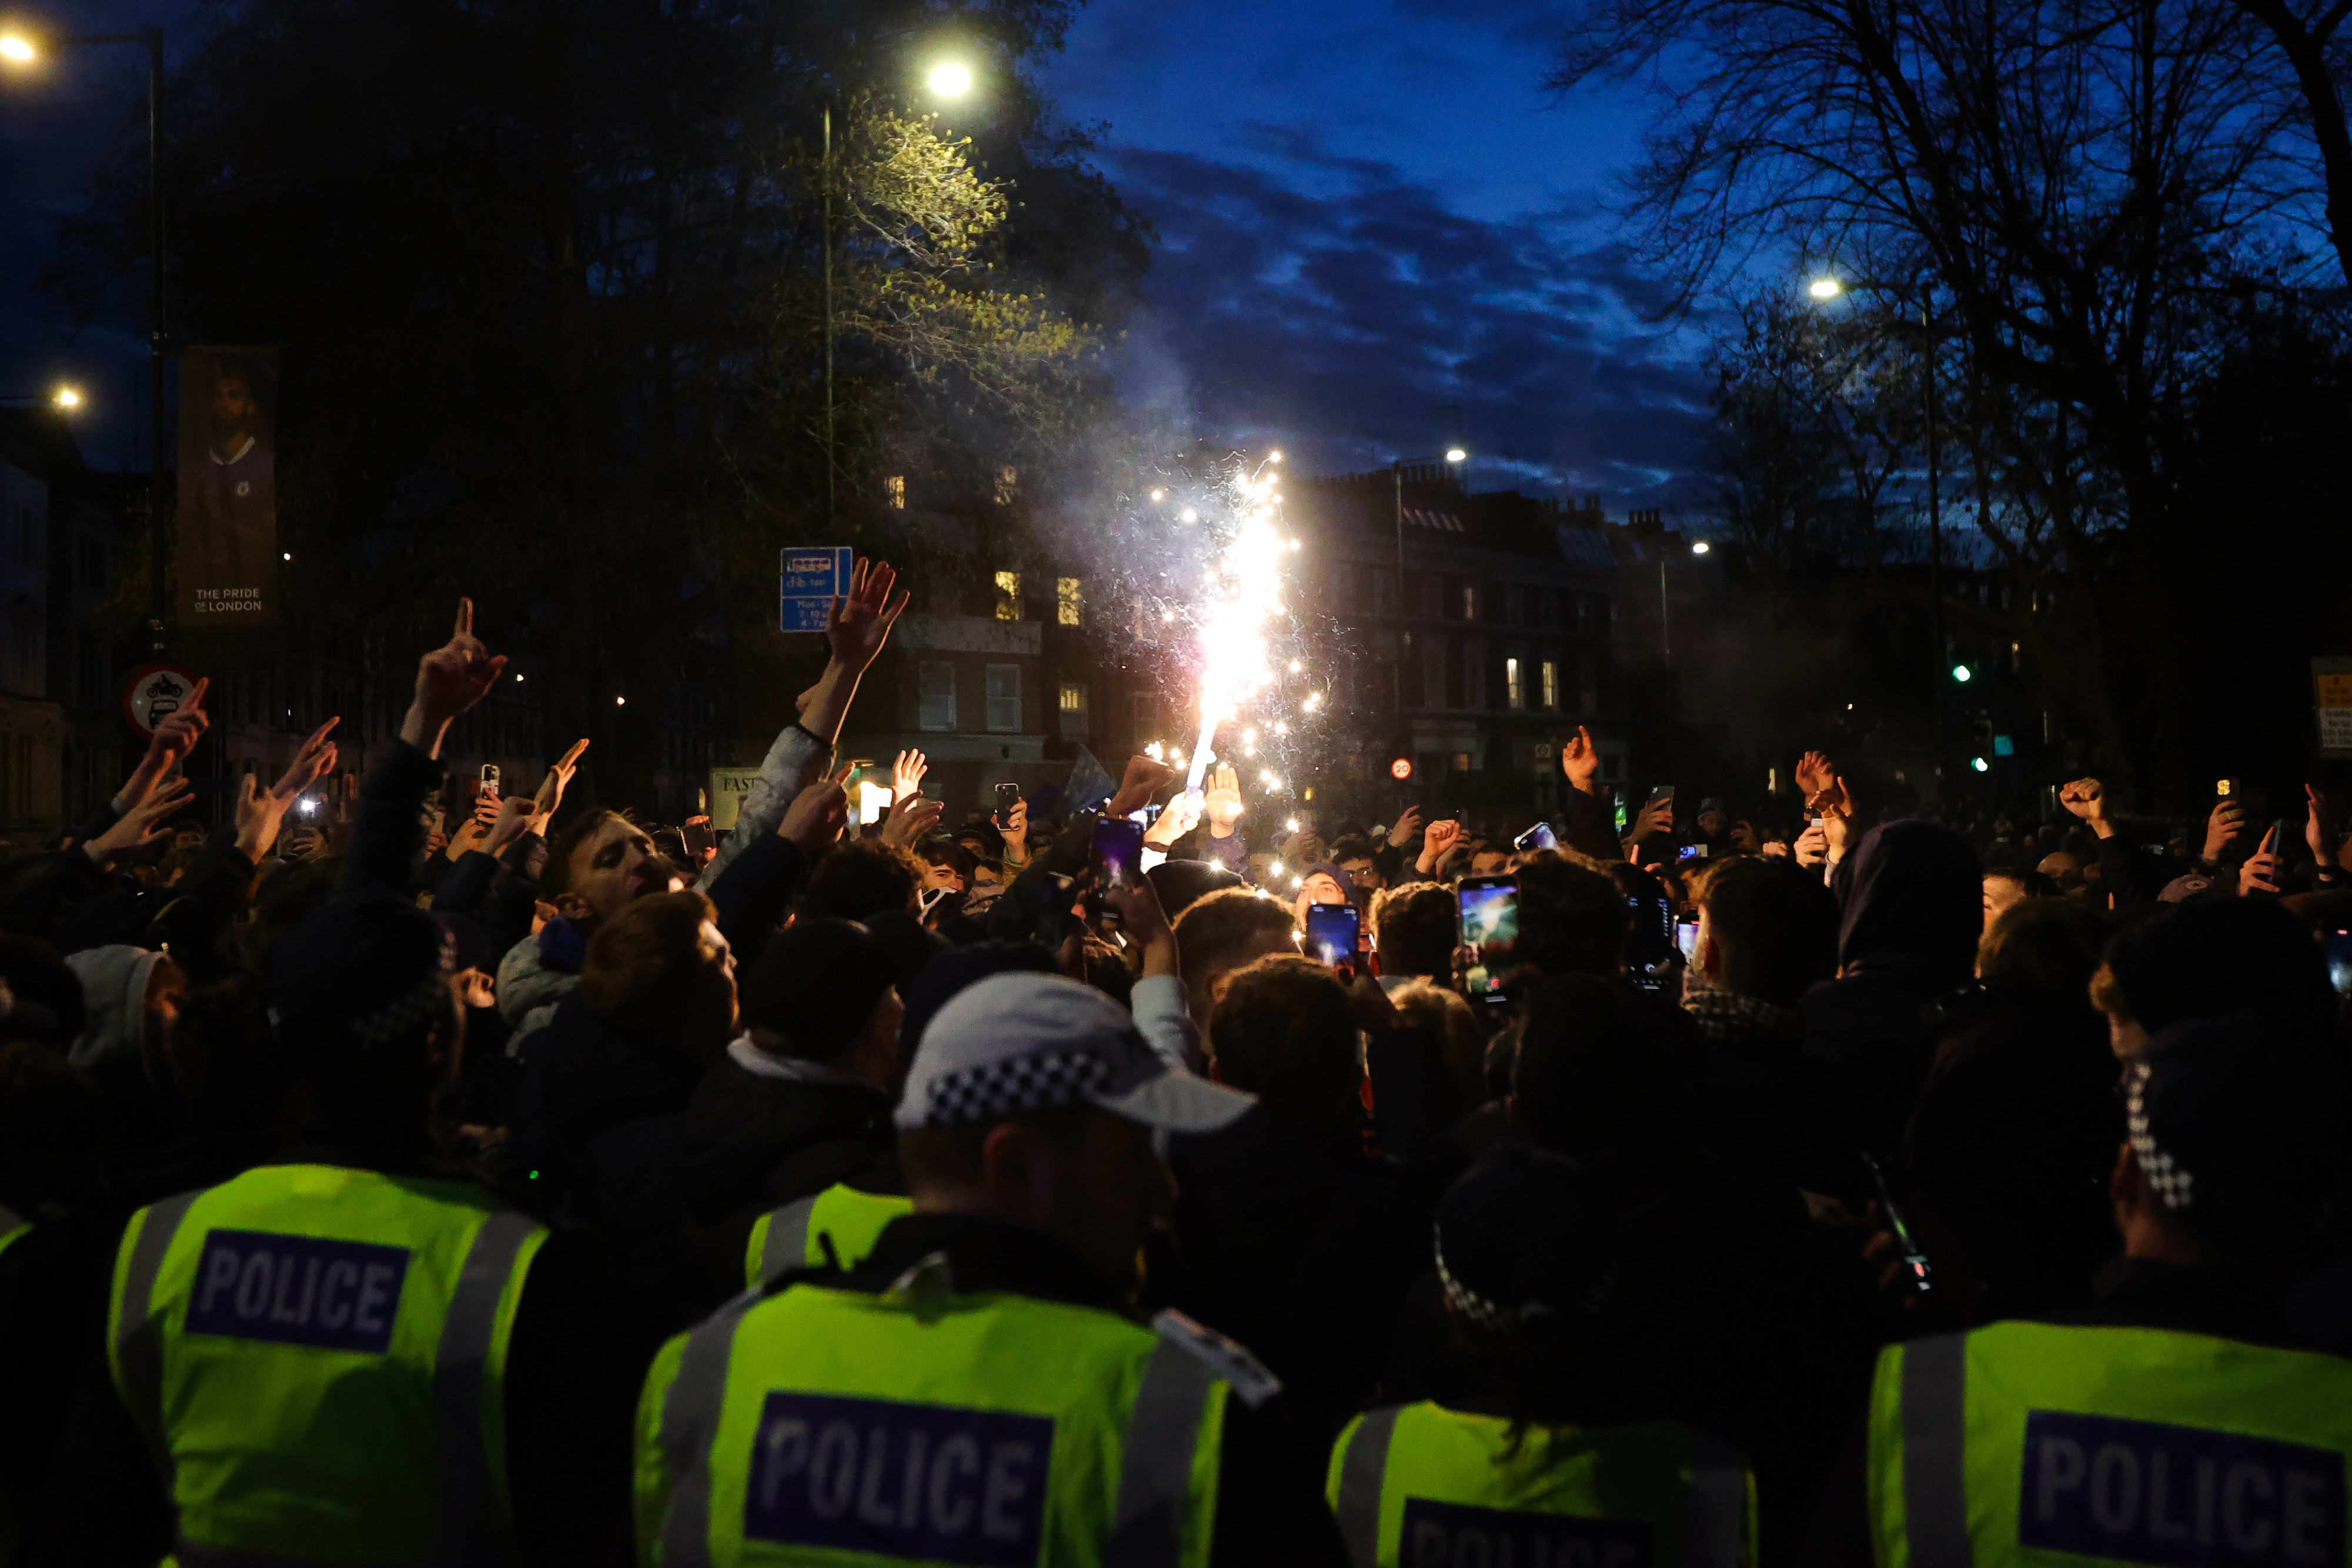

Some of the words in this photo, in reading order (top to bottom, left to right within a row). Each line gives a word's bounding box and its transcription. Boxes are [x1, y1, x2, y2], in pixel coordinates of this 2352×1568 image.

[196, 589, 220, 599] THE
[223, 588, 260, 598] PRIDE
[209, 600, 262, 611] LONDON
[1395, 764, 1409, 774] 20
[198, 1247, 395, 1333] POLICE
[759, 1417, 1034, 1542] POLICE
[2034, 1436, 2330, 1564] POLICE
